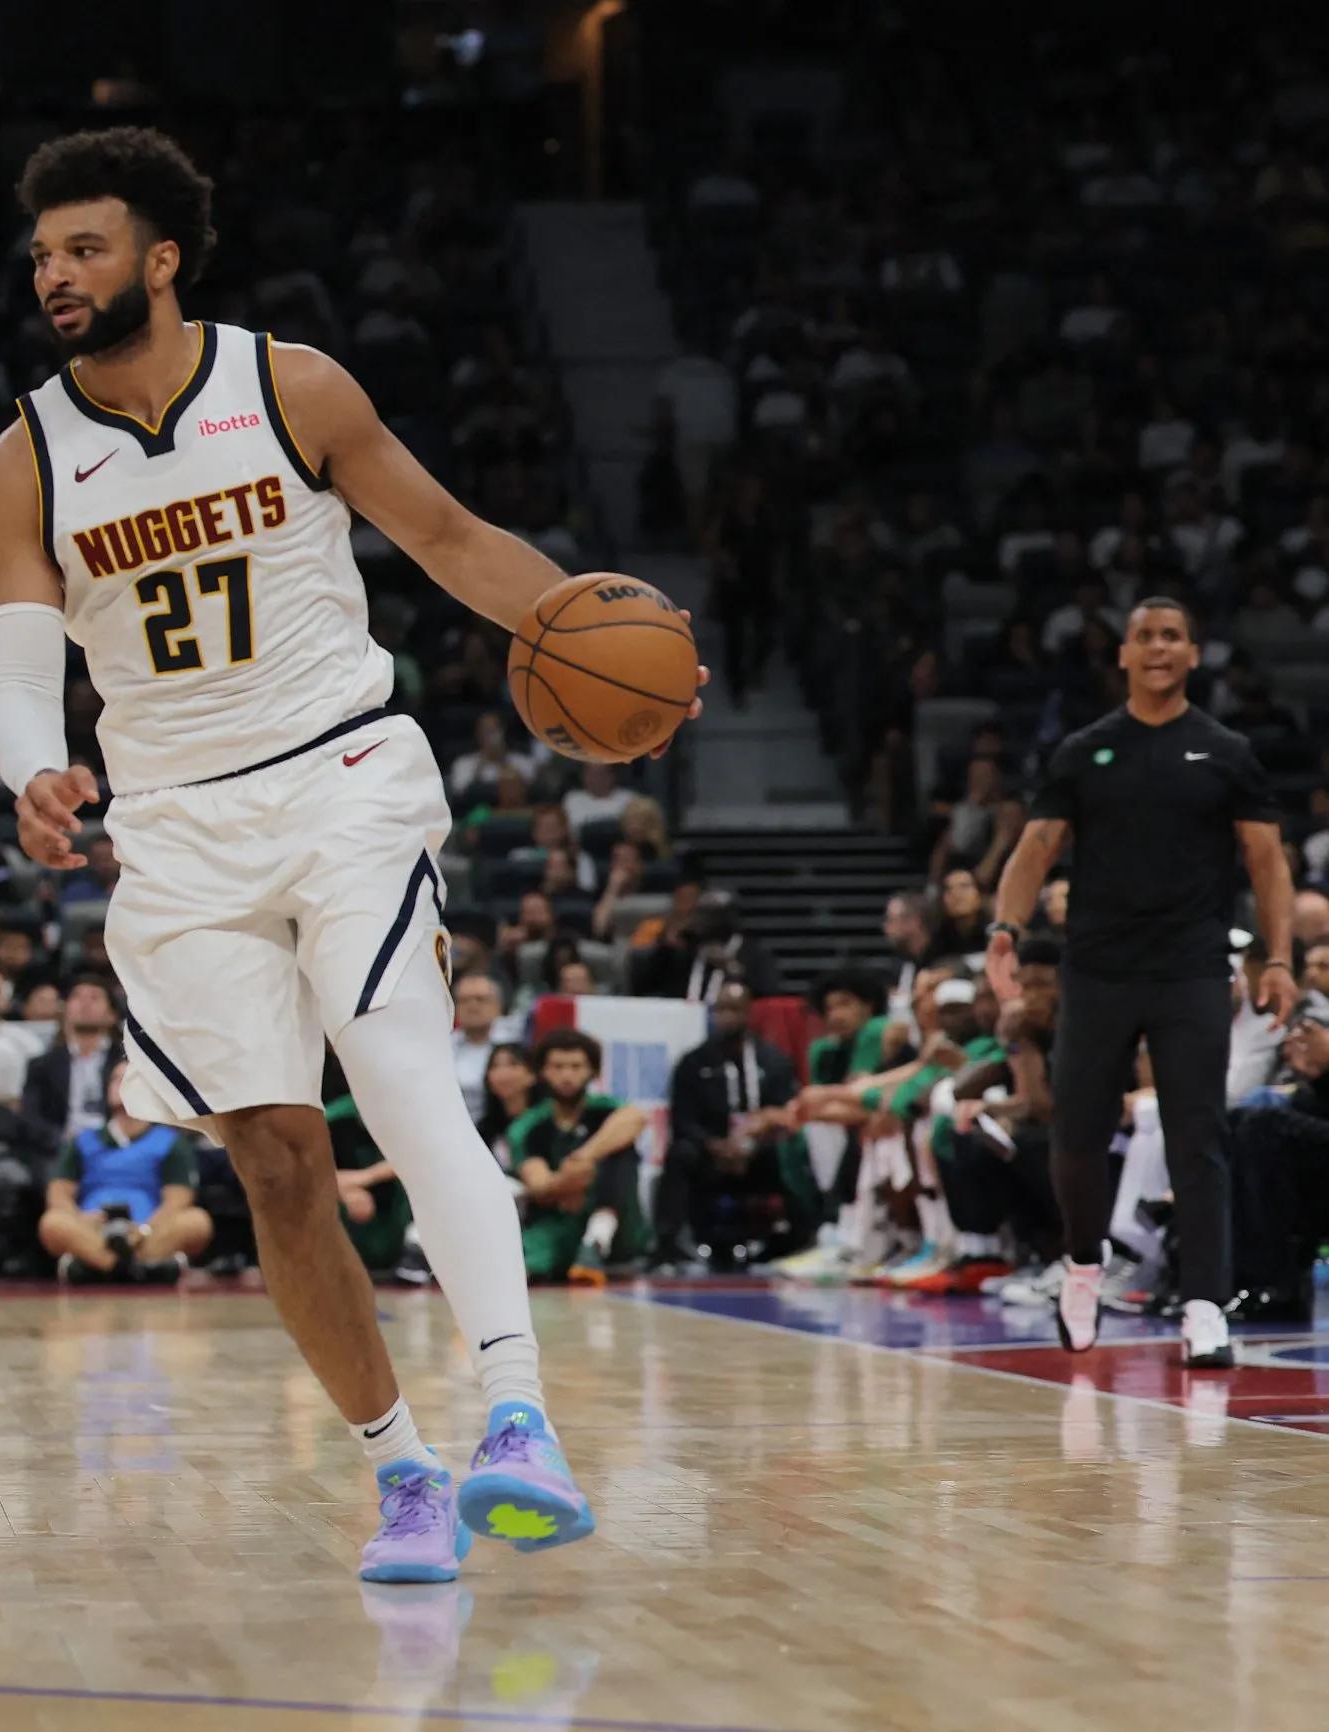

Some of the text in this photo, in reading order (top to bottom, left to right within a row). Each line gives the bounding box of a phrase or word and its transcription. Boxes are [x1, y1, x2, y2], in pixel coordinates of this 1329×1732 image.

[198, 413, 261, 436] ibotta
[72, 475, 286, 578] NUGGETS
[133, 553, 255, 677] 27
